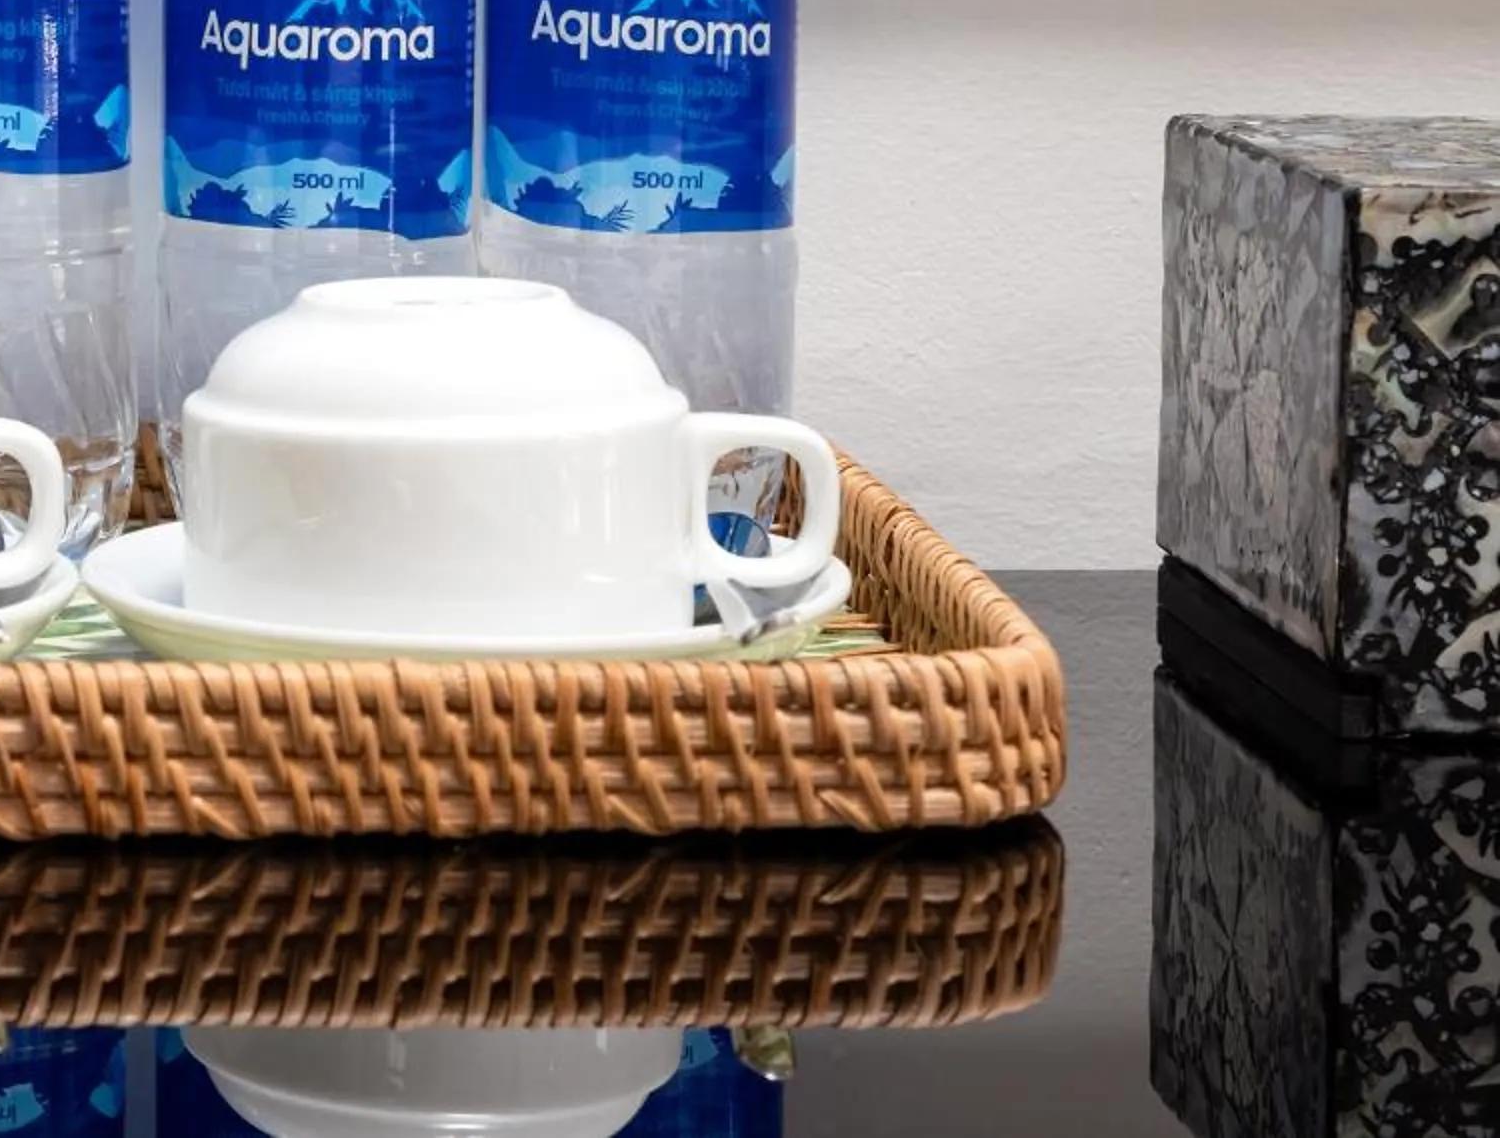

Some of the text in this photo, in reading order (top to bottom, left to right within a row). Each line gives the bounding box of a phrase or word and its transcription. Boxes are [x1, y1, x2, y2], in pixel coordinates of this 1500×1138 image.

[201, 10, 434, 70] Aquaroma
[531, 0, 771, 61] Aquaroma
[292, 172, 364, 190] 500 ml
[632, 171, 703, 189] 500 ml
